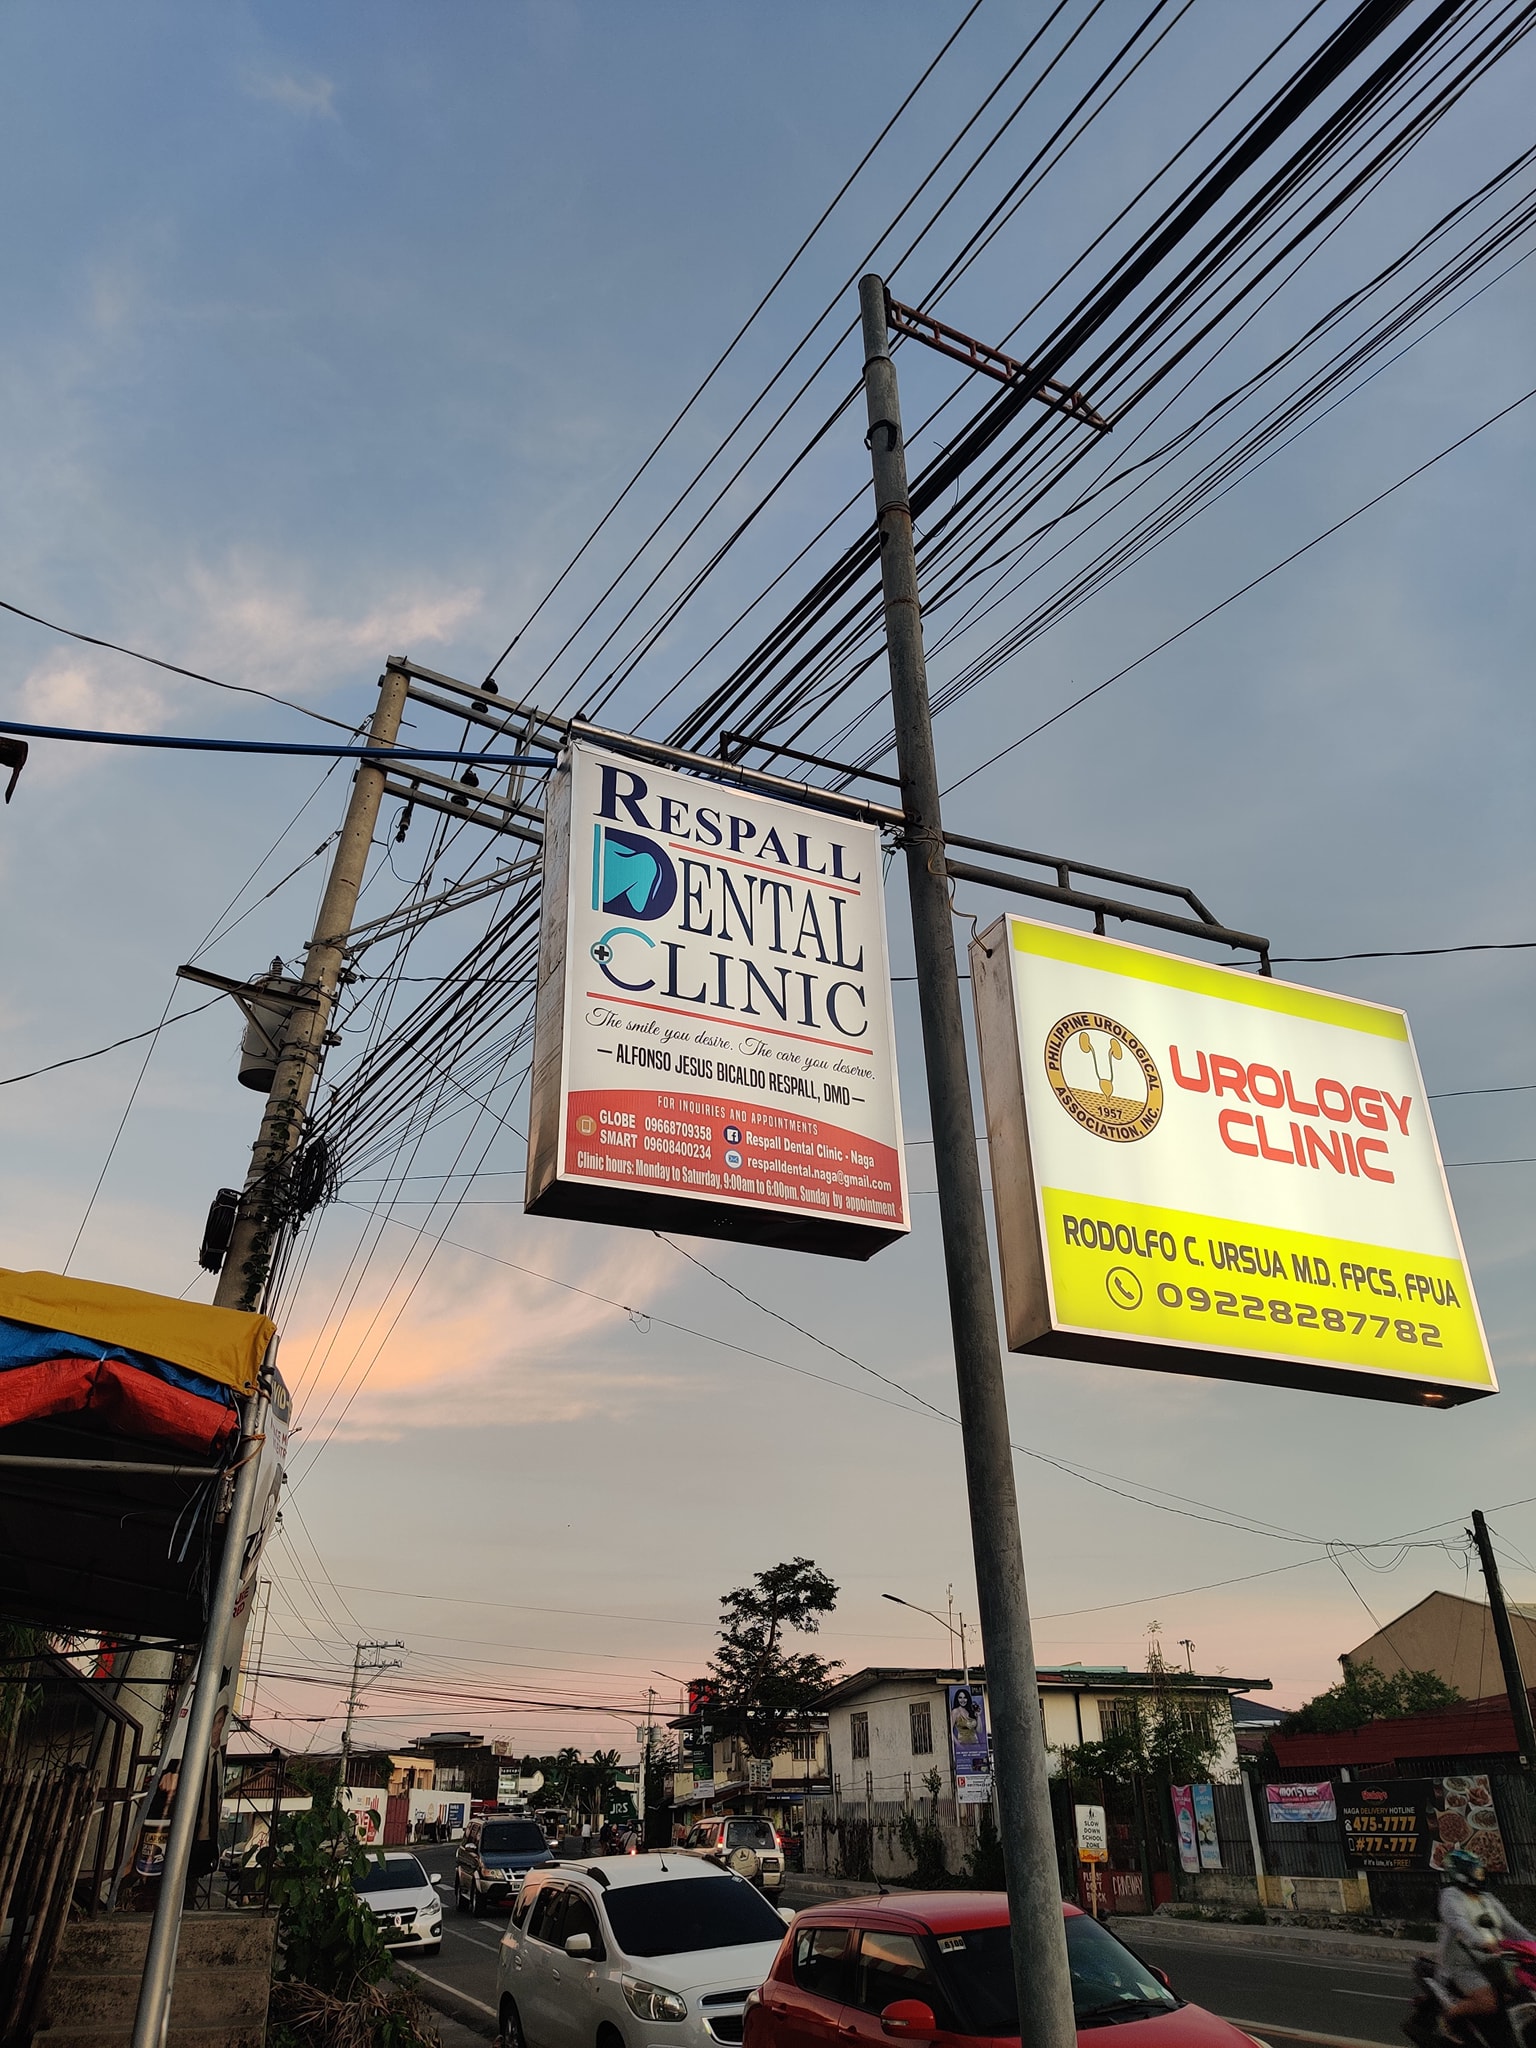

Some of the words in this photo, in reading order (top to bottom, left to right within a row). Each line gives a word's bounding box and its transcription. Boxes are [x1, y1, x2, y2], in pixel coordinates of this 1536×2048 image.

[593, 763, 861, 884] RESPALL
[592, 824, 863, 972] DENTAL
[590, 926, 868, 1037] CLINIC
[585, 1007, 622, 1028] The
[626, 1020, 660, 1036] smile
[660, 1029, 691, 1044] you
[694, 1030, 733, 1051] desire.
[738, 1037, 772, 1056] The
[776, 1049, 801, 1064] care
[801, 1057, 829, 1072] you
[832, 1058, 876, 1080] deserve.
[1048, 1014, 1090, 1071] PHILIPPINE
[1094, 1015, 1160, 1091] UROLOGICAL
[616, 1043, 671, 1072] ALFONSO
[675, 1054, 713, 1080] JESUS
[717, 1061, 766, 1089] BICALDO
[769, 1072, 821, 1103] RESPALL,
[824, 1083, 850, 1106] DMD
[1169, 1044, 1412, 1137] UROLOGY
[599, 1109, 636, 1129] GLOBE
[644, 1116, 713, 1141] 09668709358
[657, 1095, 675, 1110] FOR
[679, 1099, 726, 1119] INQUIRIES
[729, 1108, 748, 1123] AND
[750, 1112, 819, 1136] APPOINTMENTS
[1055, 1086, 1144, 1139] ASSOCIATION,
[1140, 1107, 1160, 1130] INC.
[1098, 1106, 1123, 1120] 1957
[600, 1129, 638, 1149] SMART
[643, 1135, 712, 1160] 09608400234
[745, 1131, 781, 1151] Respall
[784, 1138, 814, 1156] Dental
[816, 1143, 843, 1162] Clinic
[850, 1150, 875, 1170] Naga
[1218, 1108, 1395, 1184] CLINIC
[577, 1150, 605, 1170] Clinic
[606, 1155, 634, 1175] hours:
[636, 1158, 670, 1182] Monday
[672, 1166, 680, 1182] to
[682, 1166, 723, 1190] Saturday,
[724, 1172, 755, 1195] 9:00am
[756, 1178, 765, 1195] to
[800, 1185, 830, 1207] Sunday
[832, 1191, 843, 1209] by
[845, 1195, 897, 1217] appointment
[747, 1157, 892, 1192] respalldental.naga@gmail.com
[1062, 1214, 1177, 1262] RODOLFO
[1184, 1235, 1205, 1266] C.
[1208, 1239, 1288, 1281] URSUA
[1291, 1253, 1337, 1288] M.D.
[1340, 1262, 1402, 1302] FPCS,
[1405, 1273, 1462, 1308] FPUA
[1157, 1282, 1444, 1348] 09228287782
[610, 1802, 629, 1815] JRS
[1343, 1807, 1360, 1815] NAGA
[1360, 1807, 1388, 1815] DELIVERY
[1389, 1806, 1416, 1814] HOTLINE
[1353, 1815, 1417, 1832] 475-7777
[1355, 1837, 1417, 1852] #77-777
[1112, 1875, 1143, 1897] DRIVEWAY
